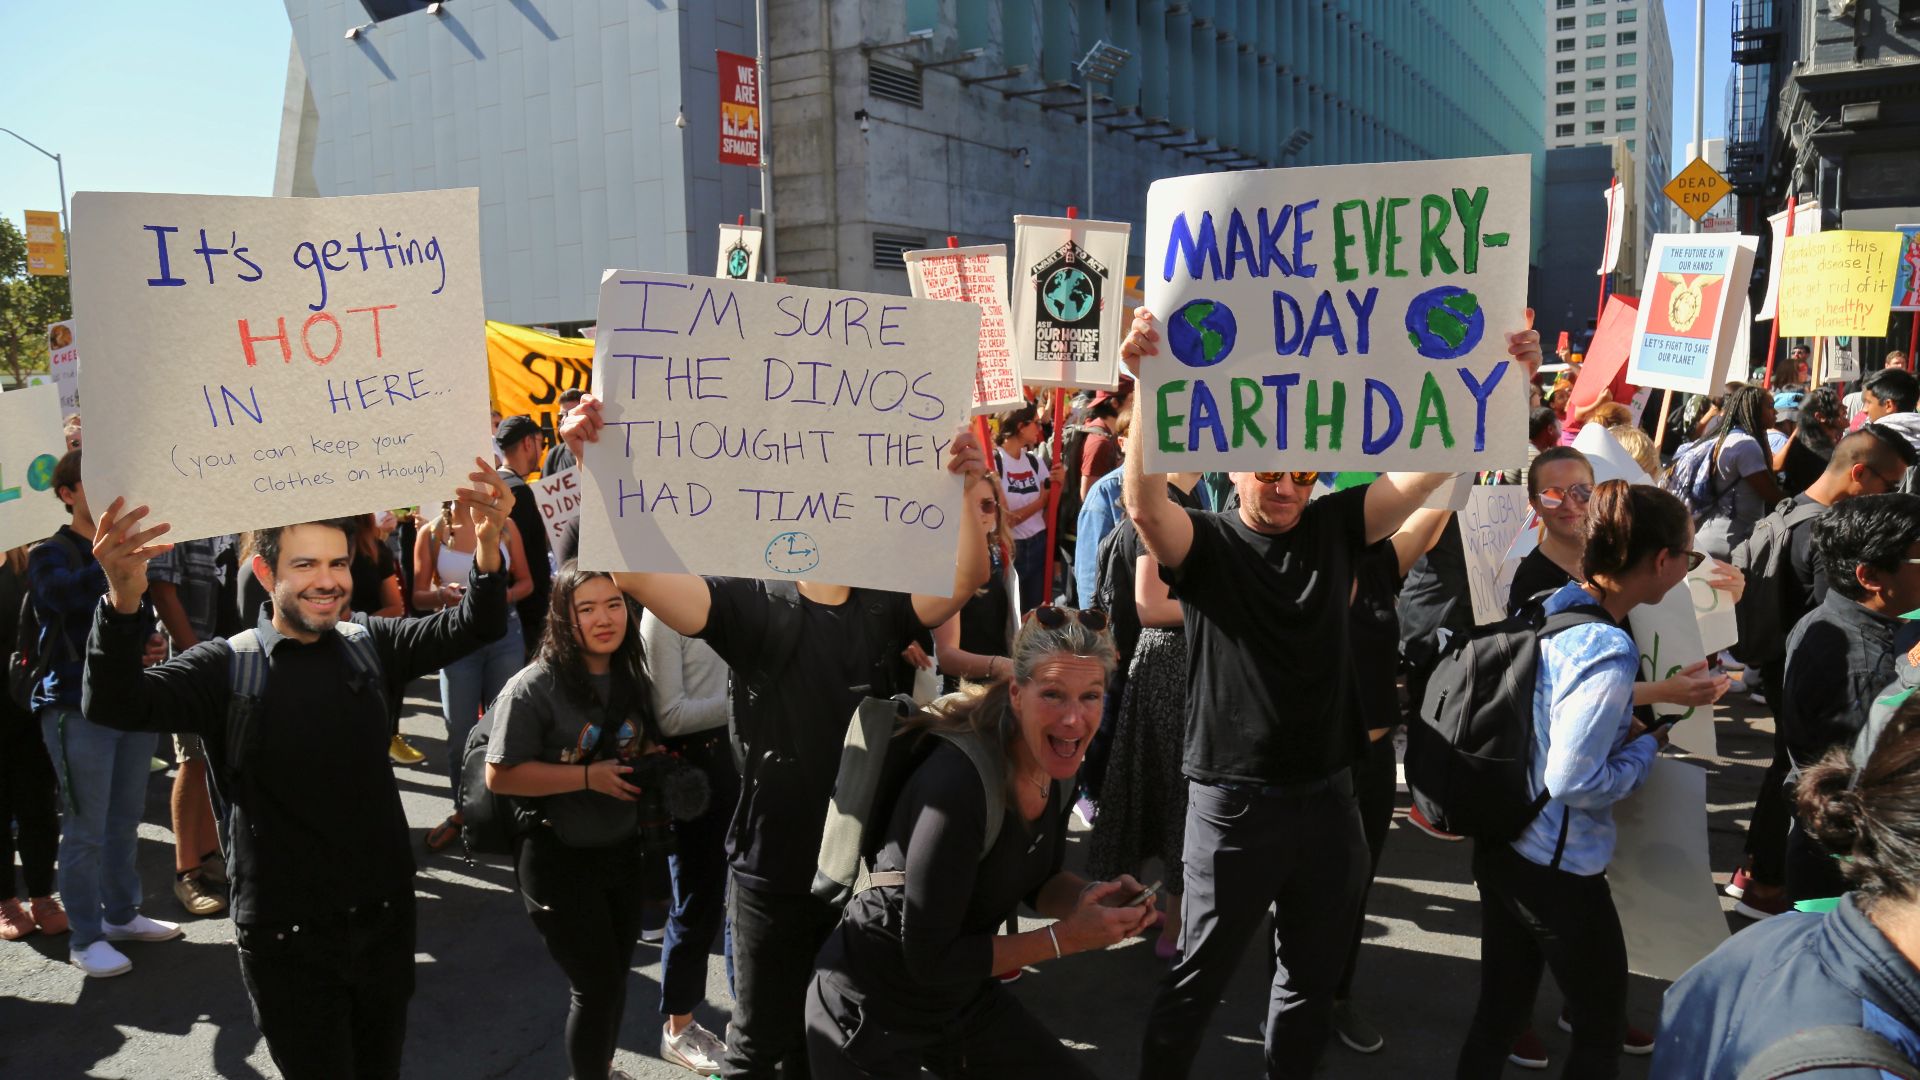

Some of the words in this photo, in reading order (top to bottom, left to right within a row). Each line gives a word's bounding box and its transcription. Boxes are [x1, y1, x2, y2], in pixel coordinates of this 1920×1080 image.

[737, 65, 754, 85] WE
[735, 84, 756, 105] ARE
[722, 137, 757, 157] SFMADE
[1678, 176, 1717, 189] DEAD
[1683, 192, 1710, 204] END
[1163, 199, 1319, 283] MAKE
[1332, 186, 1510, 283] EVERY-
[1670, 248, 1682, 257] THE
[1684, 248, 1707, 257] FUTURE
[1709, 248, 1716, 257] IS
[1717, 248, 1724, 257] IN
[1847, 238, 1878, 253] this
[1036, 255, 1058, 271] WANT
[1057, 241, 1072, 256] YOU
[1074, 246, 1087, 259] TO
[1086, 259, 1105, 272] ACT
[1678, 261, 1691, 270] OUR
[1693, 261, 1713, 271] HANDS
[143, 225, 263, 287] It's
[293, 227, 445, 311] getting
[938, 286, 959, 298] EARTH
[1807, 280, 1822, 297] get
[1829, 278, 1849, 293] rid
[1857, 276, 1872, 293] of
[1873, 279, 1888, 293] it
[979, 296, 992, 304] FOR
[1826, 298, 1874, 316] healthy
[613, 279, 744, 339] I'M
[774, 296, 907, 348] SURE
[1273, 287, 1380, 357] DAY
[238, 305, 397, 367] HOT
[1037, 328, 1060, 340] OUR
[1061, 328, 1099, 341] HOUSE
[1037, 341, 1049, 352] IS
[1051, 341, 1067, 352] ON
[1070, 341, 1098, 353] FIRE.
[1644, 338, 1663, 348] LET'S
[1665, 340, 1682, 351] FIGHT
[1684, 342, 1692, 352] TO
[1694, 343, 1709, 354] SAVE
[1037, 352, 1071, 360] BECAUSE
[1073, 352, 1082, 361] IT
[1084, 353, 1096, 361] IS.
[1658, 352, 1670, 362] OUR
[1671, 353, 1695, 365] PLANET
[612, 354, 730, 401] THE
[764, 357, 945, 421] DINOS
[973, 391, 998, 402] STRIKE
[203, 385, 263, 427] IN
[171, 444, 236, 479] (you
[254, 444, 298, 463] can
[310, 434, 360, 468] keep
[373, 431, 415, 461] your
[603, 420, 835, 465] THOUGHT
[858, 433, 951, 472] THEY
[347, 468, 371, 483] on
[378, 450, 445, 481] though)
[543, 472, 576, 496] WE
[618, 479, 712, 518] HAD
[739, 489, 855, 524] TIME
[875, 495, 945, 530] TOO
[1465, 493, 1526, 533] GLOBAL
